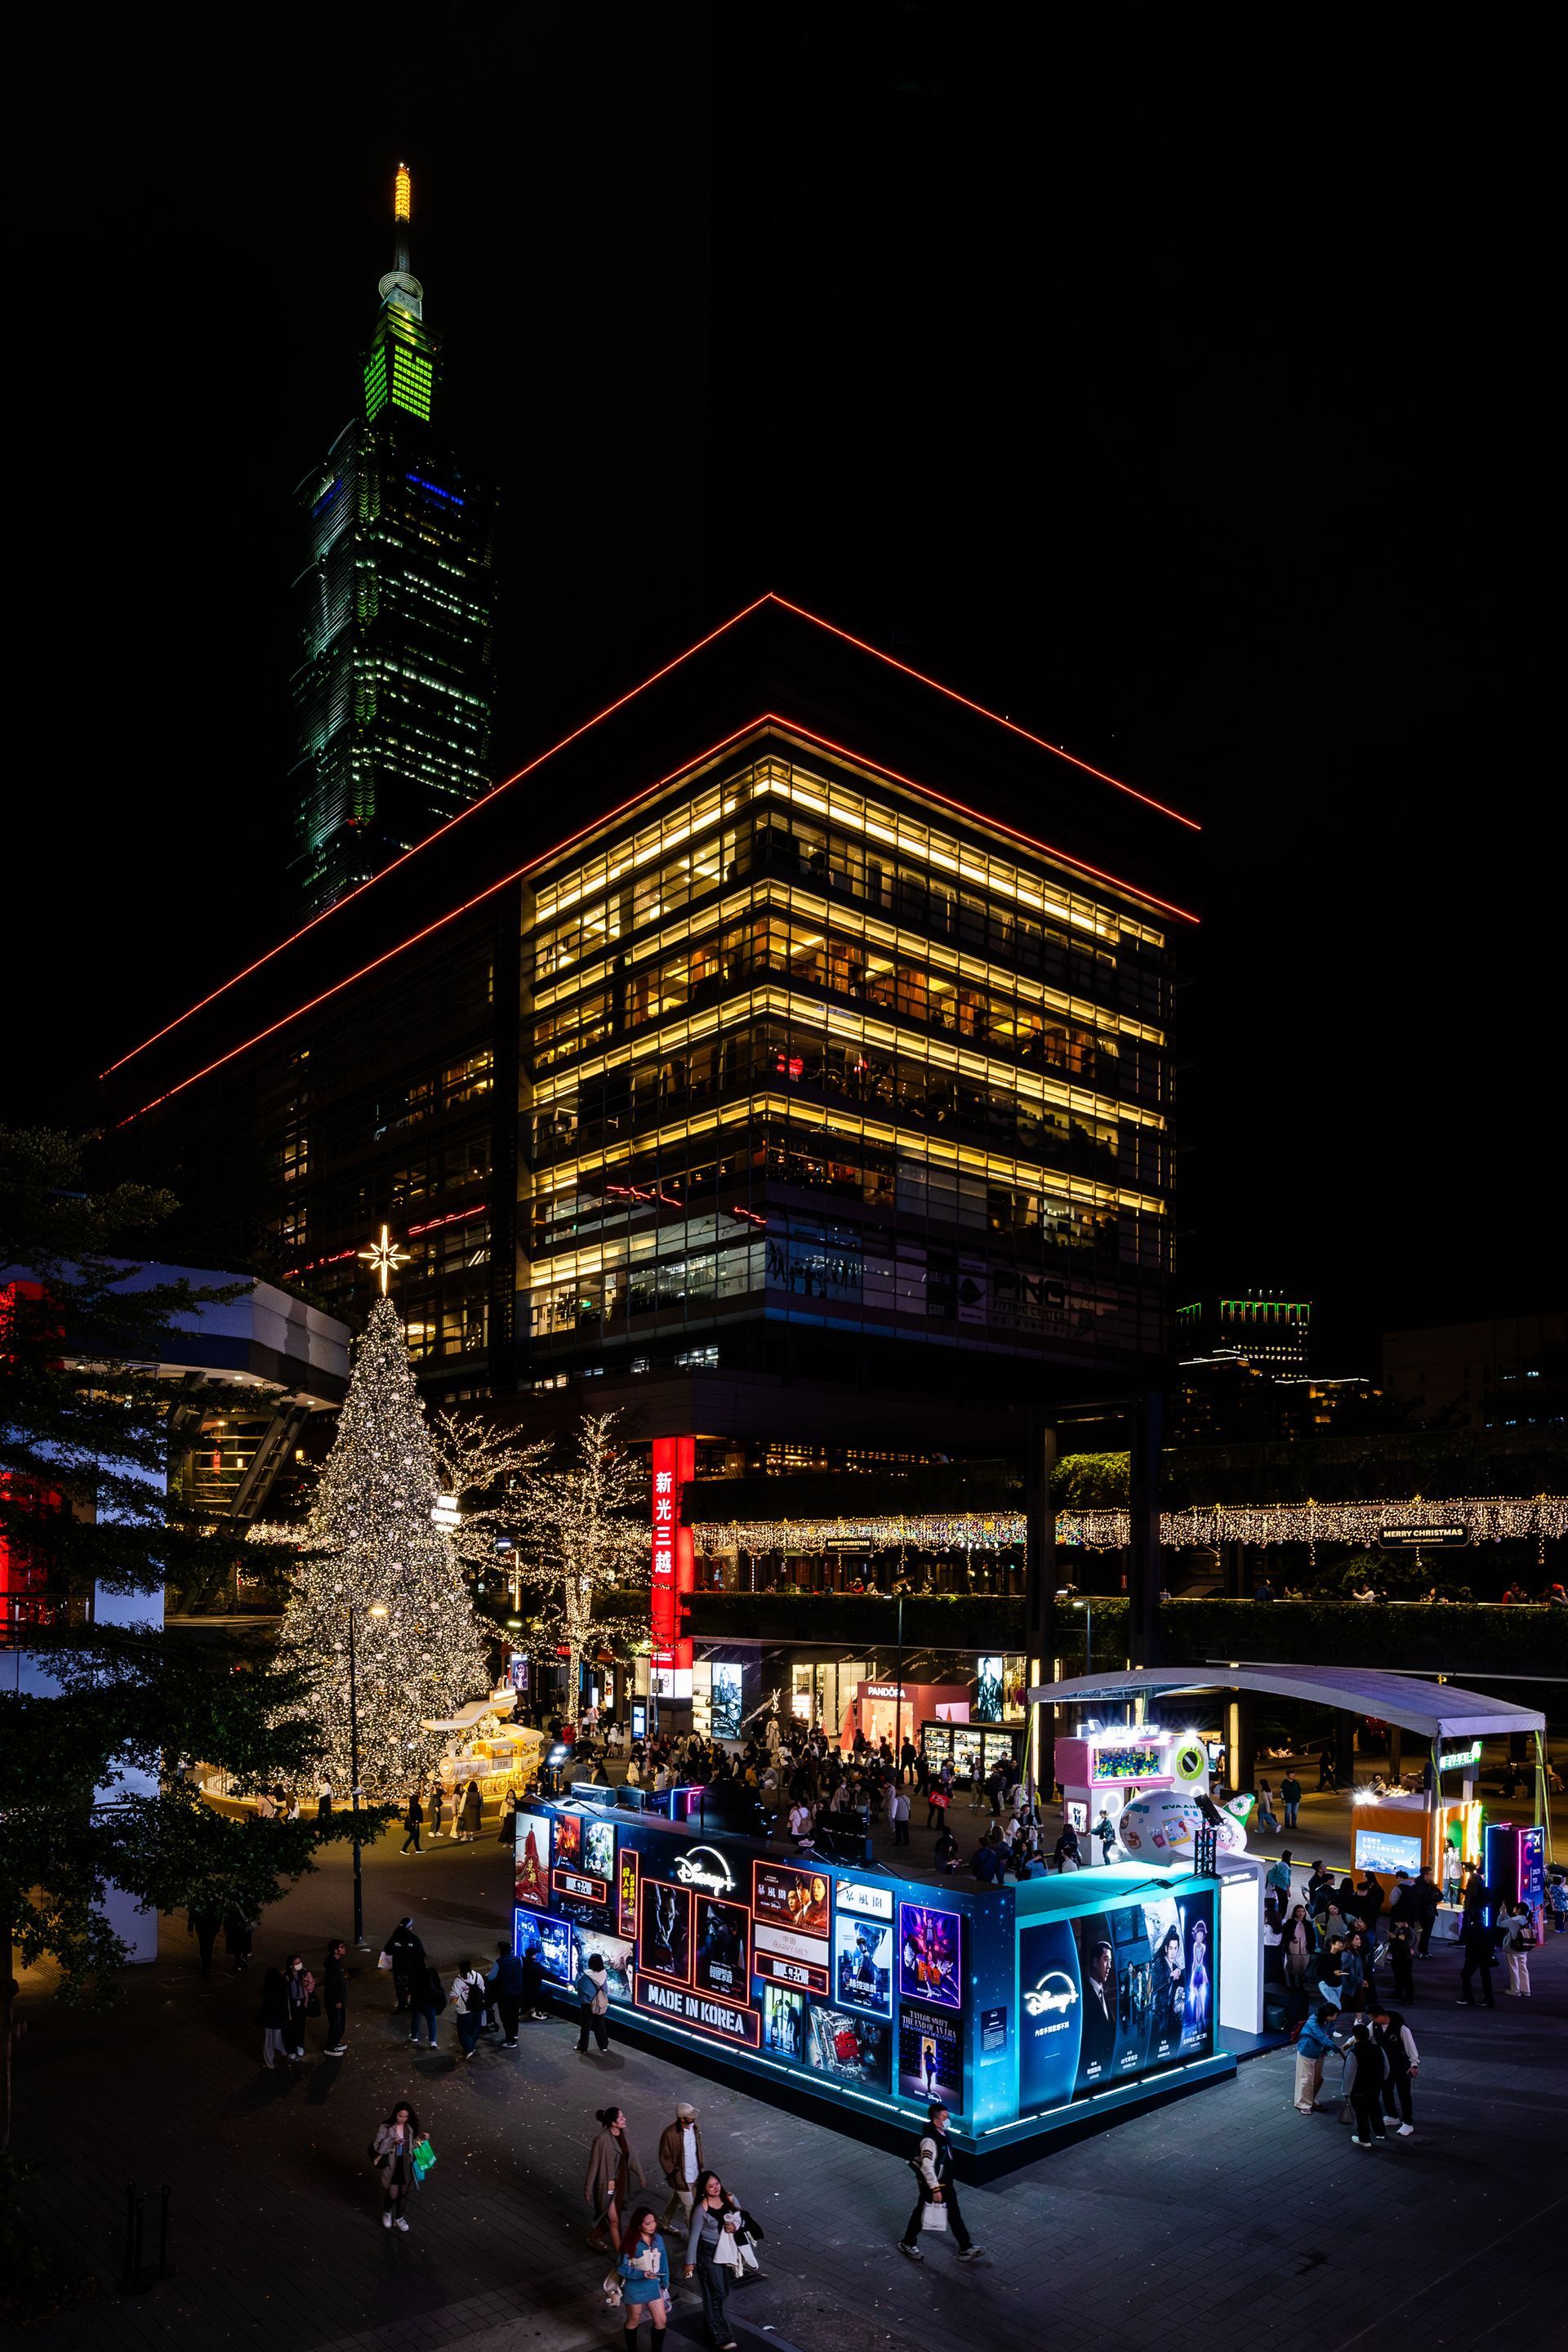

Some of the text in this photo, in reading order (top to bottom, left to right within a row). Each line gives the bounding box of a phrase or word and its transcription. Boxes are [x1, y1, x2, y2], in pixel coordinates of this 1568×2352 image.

[655, 1471, 672, 1574] 新光三越
[1413, 1529, 1463, 1537] CHRISTMAS
[621, 1867, 630, 1899] 殺人者
[675, 1851, 735, 1896] Disney+
[648, 1984, 683, 2012] MADE
[686, 1997, 698, 2018] IN
[701, 2002, 744, 2034] KOREA
[1024, 1985, 1079, 2016] Disney+
[902, 2016, 956, 2038] THE END OF AN ERA
[910, 2011, 947, 2028] TAYLOR SWIFT
[927, 2092, 942, 2103] Disney+
